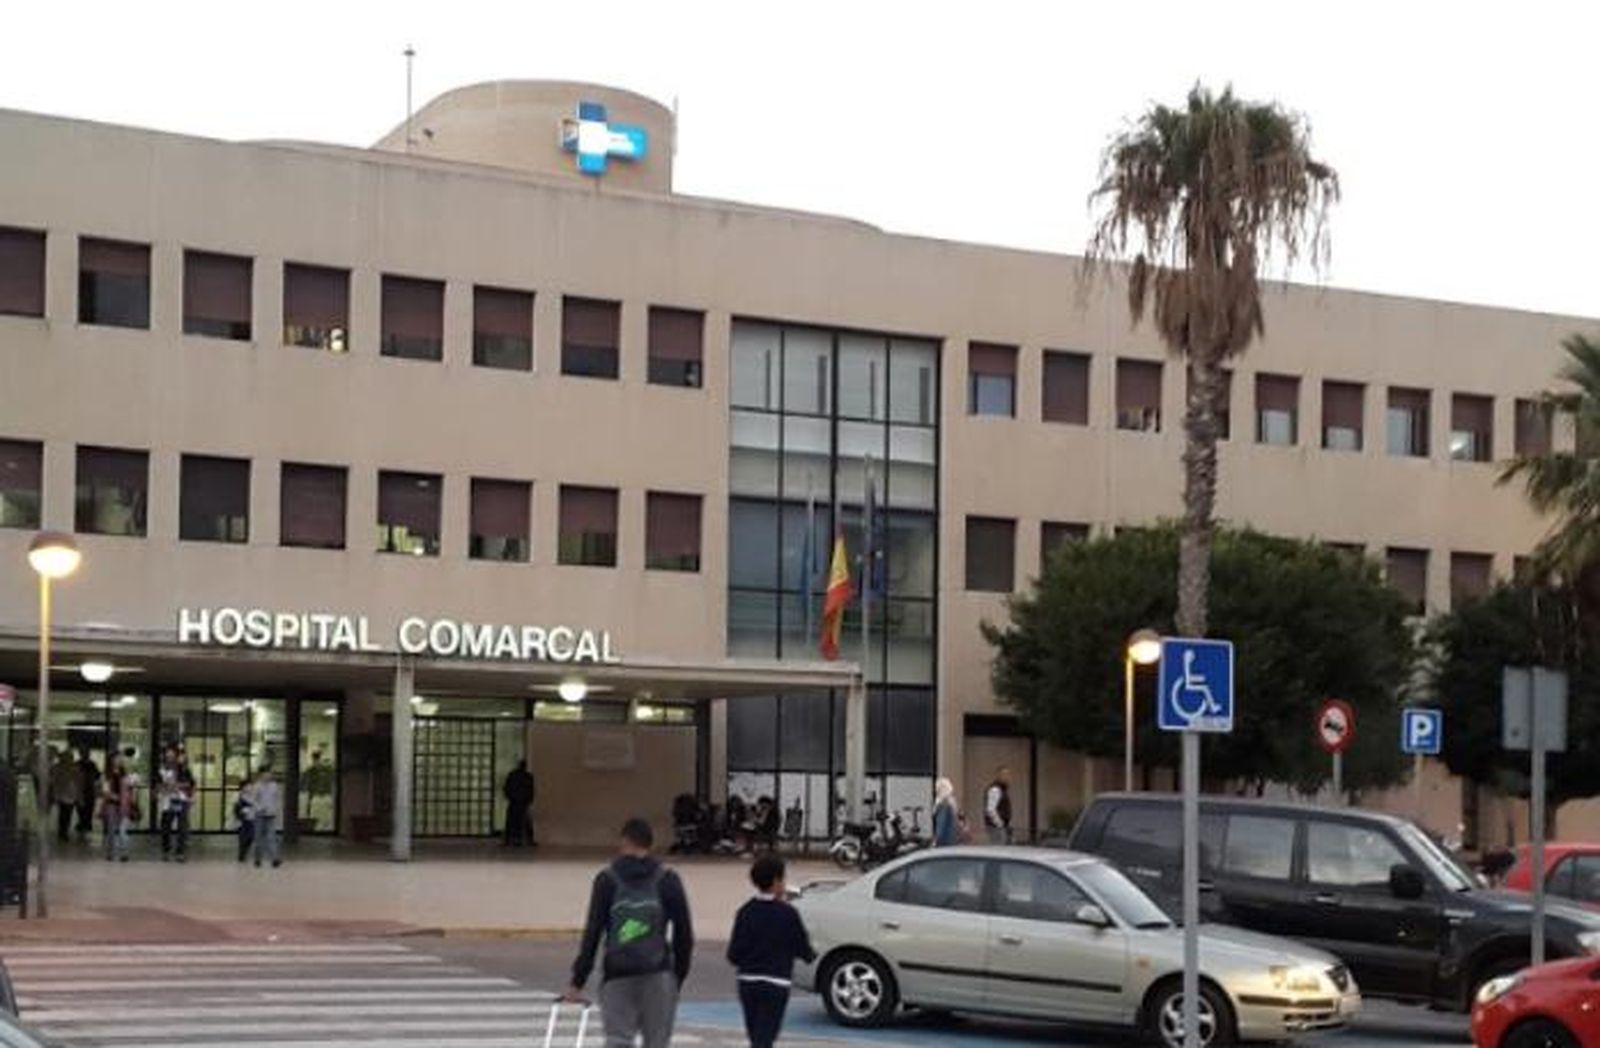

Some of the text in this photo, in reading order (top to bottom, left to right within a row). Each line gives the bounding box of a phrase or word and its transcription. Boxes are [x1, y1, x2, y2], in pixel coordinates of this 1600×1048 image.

[178, 608, 621, 663] HOSPITAL COMARCAL
[1410, 714, 1434, 746] P
